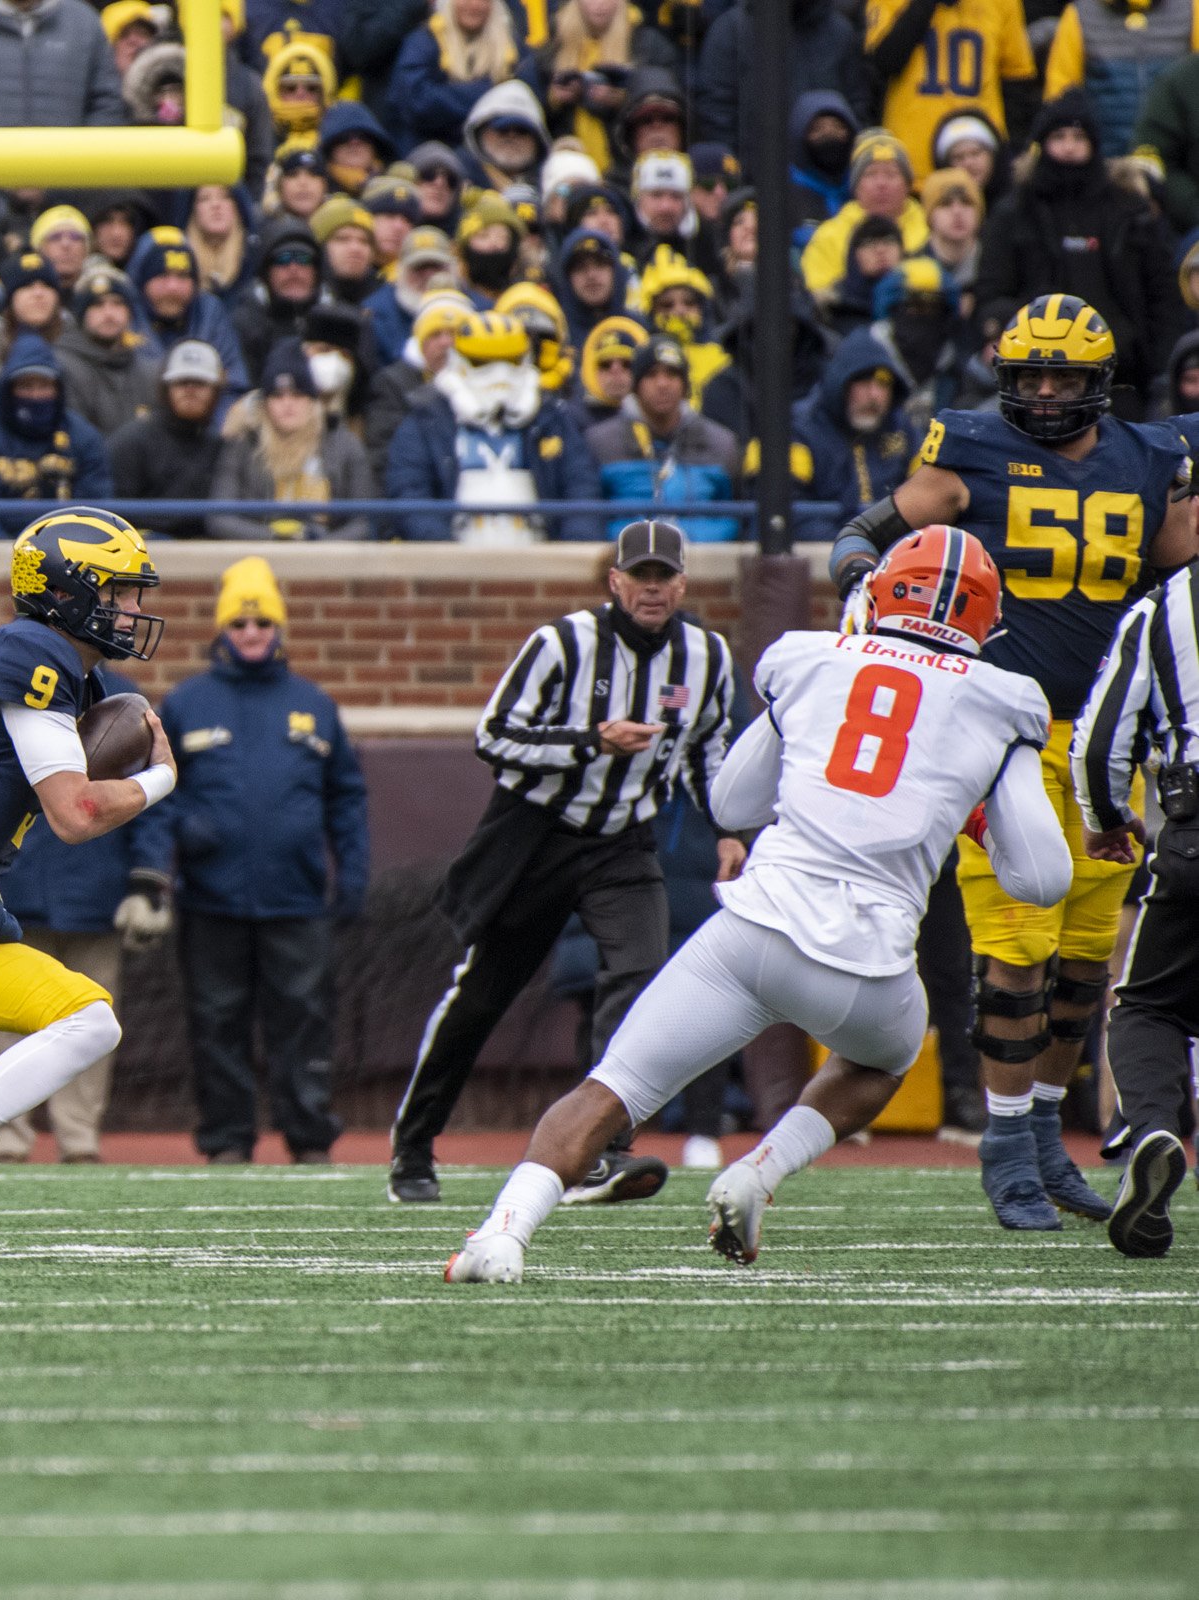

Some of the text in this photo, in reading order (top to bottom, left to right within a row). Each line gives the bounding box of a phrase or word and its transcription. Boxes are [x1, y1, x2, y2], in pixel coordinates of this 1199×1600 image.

[917, 28, 984, 96] 10
[1003, 486, 1144, 602] 58
[24, 664, 59, 710] 9
[595, 679, 609, 696] S
[655, 738, 675, 761] C
[825, 664, 923, 798] 8
